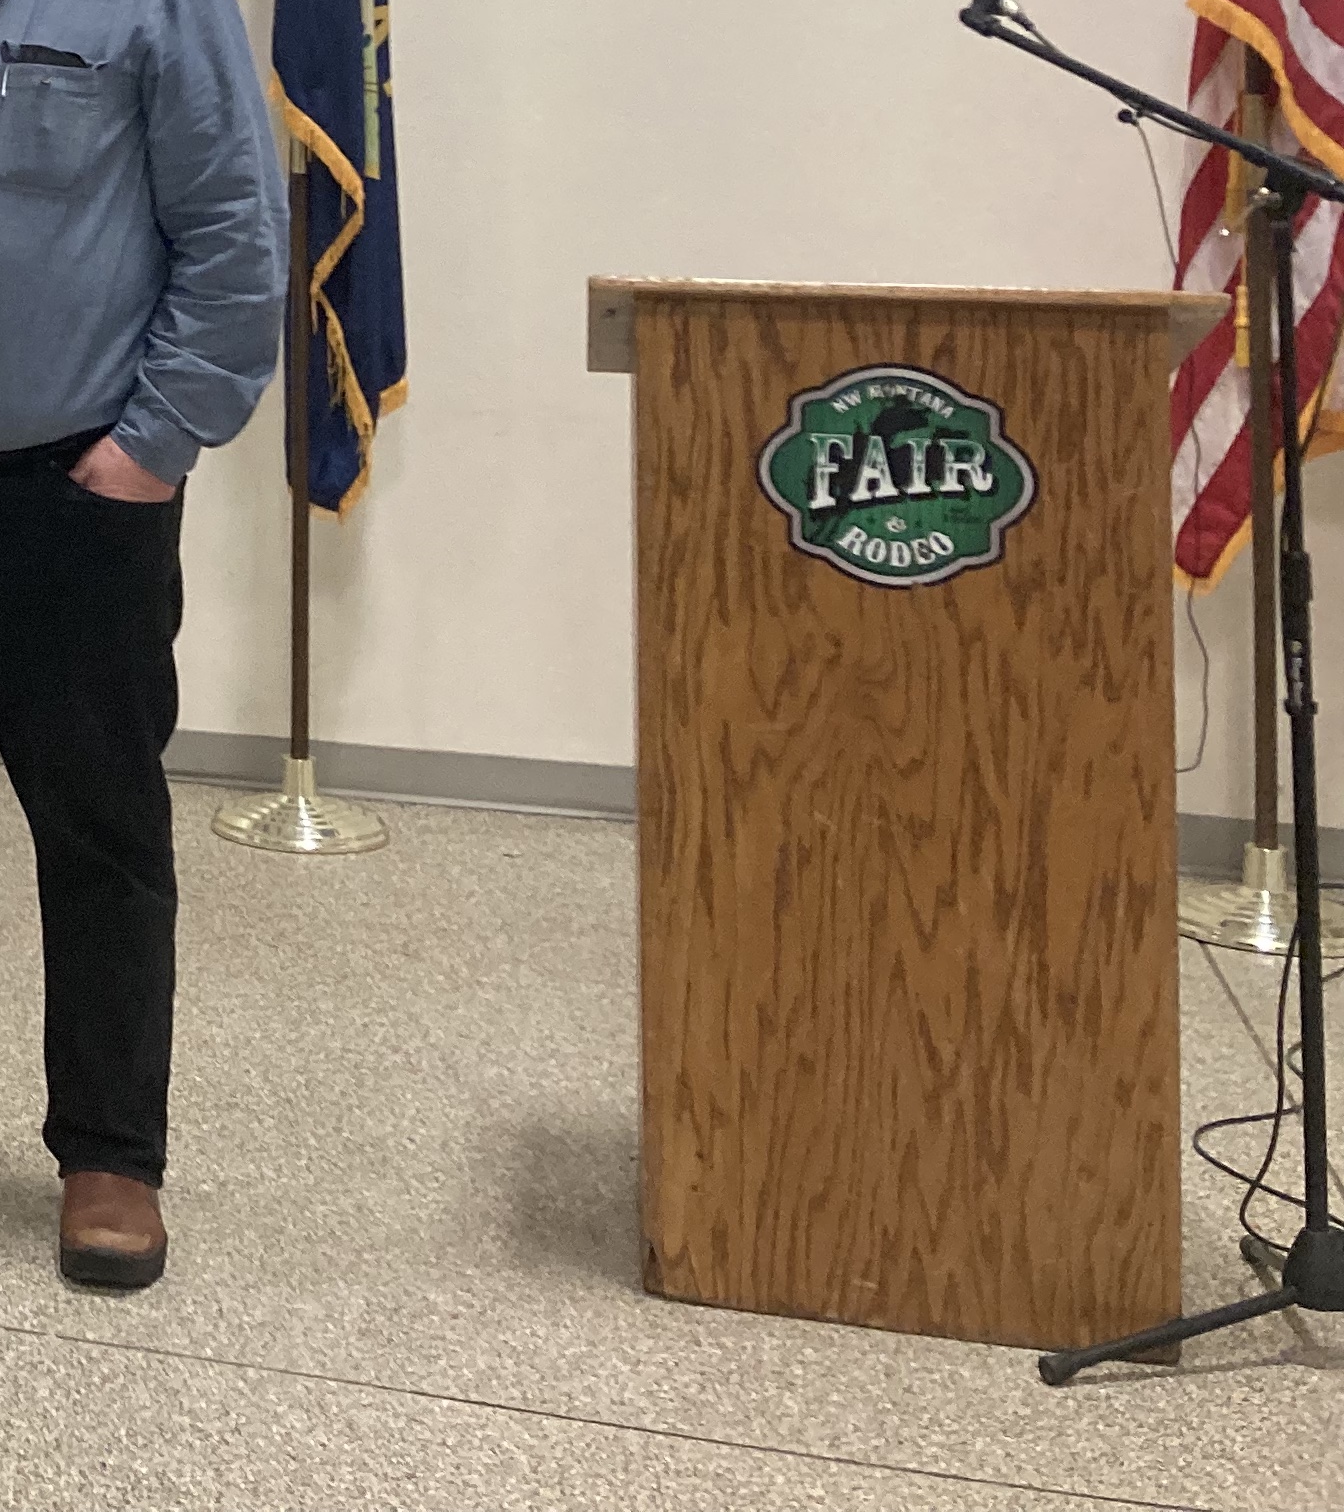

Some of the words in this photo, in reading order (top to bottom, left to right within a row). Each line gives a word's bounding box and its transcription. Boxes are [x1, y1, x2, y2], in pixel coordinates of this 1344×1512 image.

[830, 389, 862, 413] NW
[809, 433, 993, 509] FAIR
[885, 515, 907, 533] &
[838, 526, 954, 567] RODEO
